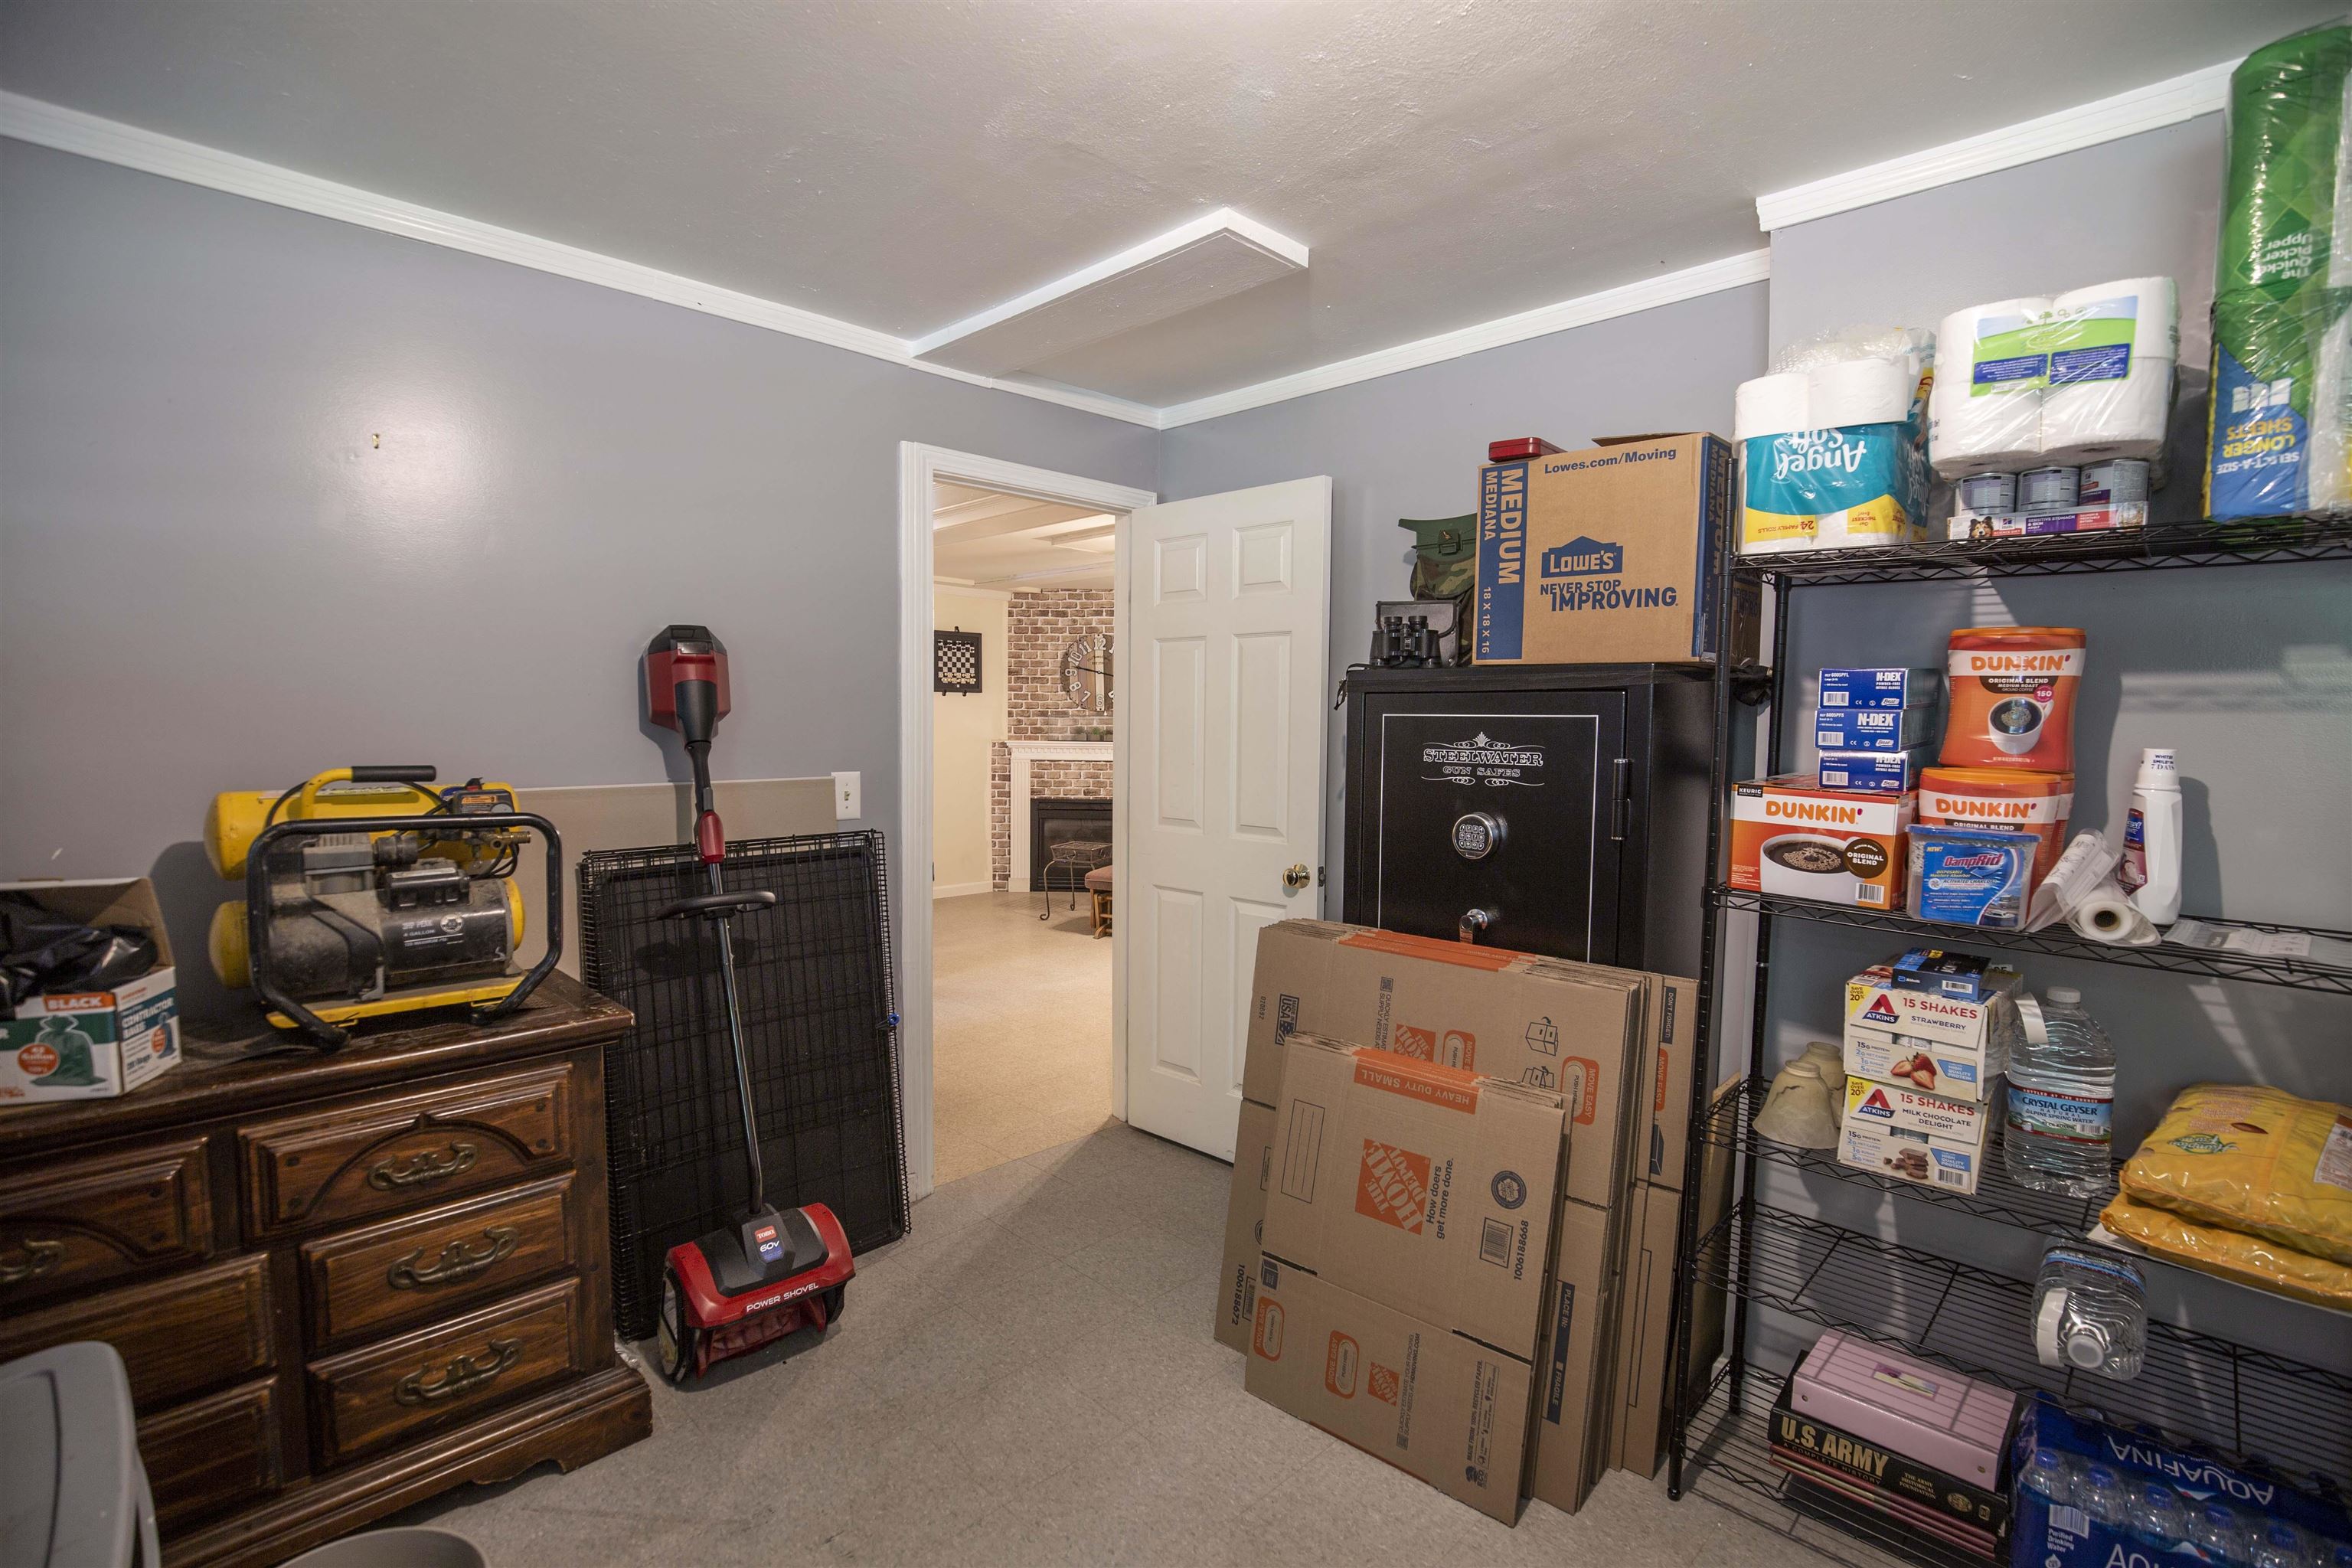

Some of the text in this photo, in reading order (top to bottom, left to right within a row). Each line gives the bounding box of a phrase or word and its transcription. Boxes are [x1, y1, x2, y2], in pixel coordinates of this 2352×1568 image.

[2267, 233, 2313, 250] Upper
[2226, 416, 2293, 440] SHEETS
[2223, 434, 2295, 458] LONGER
[1544, 448, 1677, 474] Lowes.com/Moving
[1775, 440, 1867, 479] Angel
[1484, 472, 1498, 541] MEDIANA
[1498, 469, 1524, 584] MEDIUM
[1800, 521, 1815, 531] 24
[1550, 550, 1615, 573] LOWE'S
[1483, 587, 1491, 599] 18
[1540, 580, 1621, 595] NEVER STOP
[1551, 587, 1677, 612] IMPROVING
[1482, 614, 1491, 626] 18
[1079, 641, 1092, 655] 11
[1094, 637, 1106, 650] 12
[1481, 642, 1489, 653] 16
[1068, 651, 1082, 666] 10
[1971, 655, 2071, 671] DUNKIN'
[1877, 672, 1901, 681] N-DEX
[1081, 690, 1091, 702] 7
[1857, 714, 1894, 727] N-DEX
[1423, 748, 1544, 766] STEELWATER
[1442, 766, 1521, 777] GUN SAFES
[1766, 800, 1863, 825] DUNKIN'
[1936, 798, 2037, 818] DUNKIN'
[1847, 851, 1884, 861] ORIGINAL
[1852, 858, 1877, 866] BLEND
[1943, 853, 2004, 869] DampRid
[47, 997, 103, 1010] BLACK
[1280, 998, 1292, 1018] USA
[1903, 998, 1978, 1019] 15 SHAKES
[1380, 994, 1392, 1051] QUICKLY ESTIMAT
[1866, 1012, 1896, 1023] ATKINS
[1911, 1016, 1966, 1031] STRAWBERRY
[1464, 1040, 1473, 1065] MOVE
[1361, 1069, 1469, 1105] HEAVY DUTY SMALL
[1584, 1068, 1596, 1118] MOVE EASY
[1861, 1107, 1891, 1118] ATKINS
[1900, 1093, 1975, 1116] 15 SHAKES
[2022, 1096, 2098, 1116] CRYSTAL GEYSER
[1902, 1108, 1971, 1127] MILK CHOCOLATE
[1918, 1119, 1954, 1130] DELIGHT
[2026, 1109, 2048, 1118] ALPINE
[2049, 1113, 2072, 1122] SPRING
[1387, 1148, 1426, 1202] DEPOT
[1364, 1142, 1423, 1230] HOME
[1426, 1166, 1442, 1224] How doers
[1365, 1178, 1392, 1214] THE
[1436, 1158, 1454, 1240] get more done.
[757, 1230, 775, 1240] TORO
[1514, 1220, 1529, 1281] 1006188668
[746, 1282, 819, 1312] POWER SHOVEL
[1231, 1263, 1246, 1326] 1006188672
[1562, 1289, 1572, 1314] PLACE
[1553, 1367, 1563, 1405] FRAGILE
[1781, 1416, 1890, 1477] U.S. ARMY
[1792, 1446, 1881, 1485] COMPLETE HISTORY
[2107, 1434, 2274, 1505] AQUAFINA
[1899, 1481, 1936, 1499] FOUNDATION
[1901, 1477, 1935, 1494] HISTORICAL
[1917, 1478, 1934, 1487] ARMY
[2047, 1535, 2074, 1550] Drinking
[2048, 1528, 2073, 1542] Purified
[2047, 1542, 2066, 1553] Water
